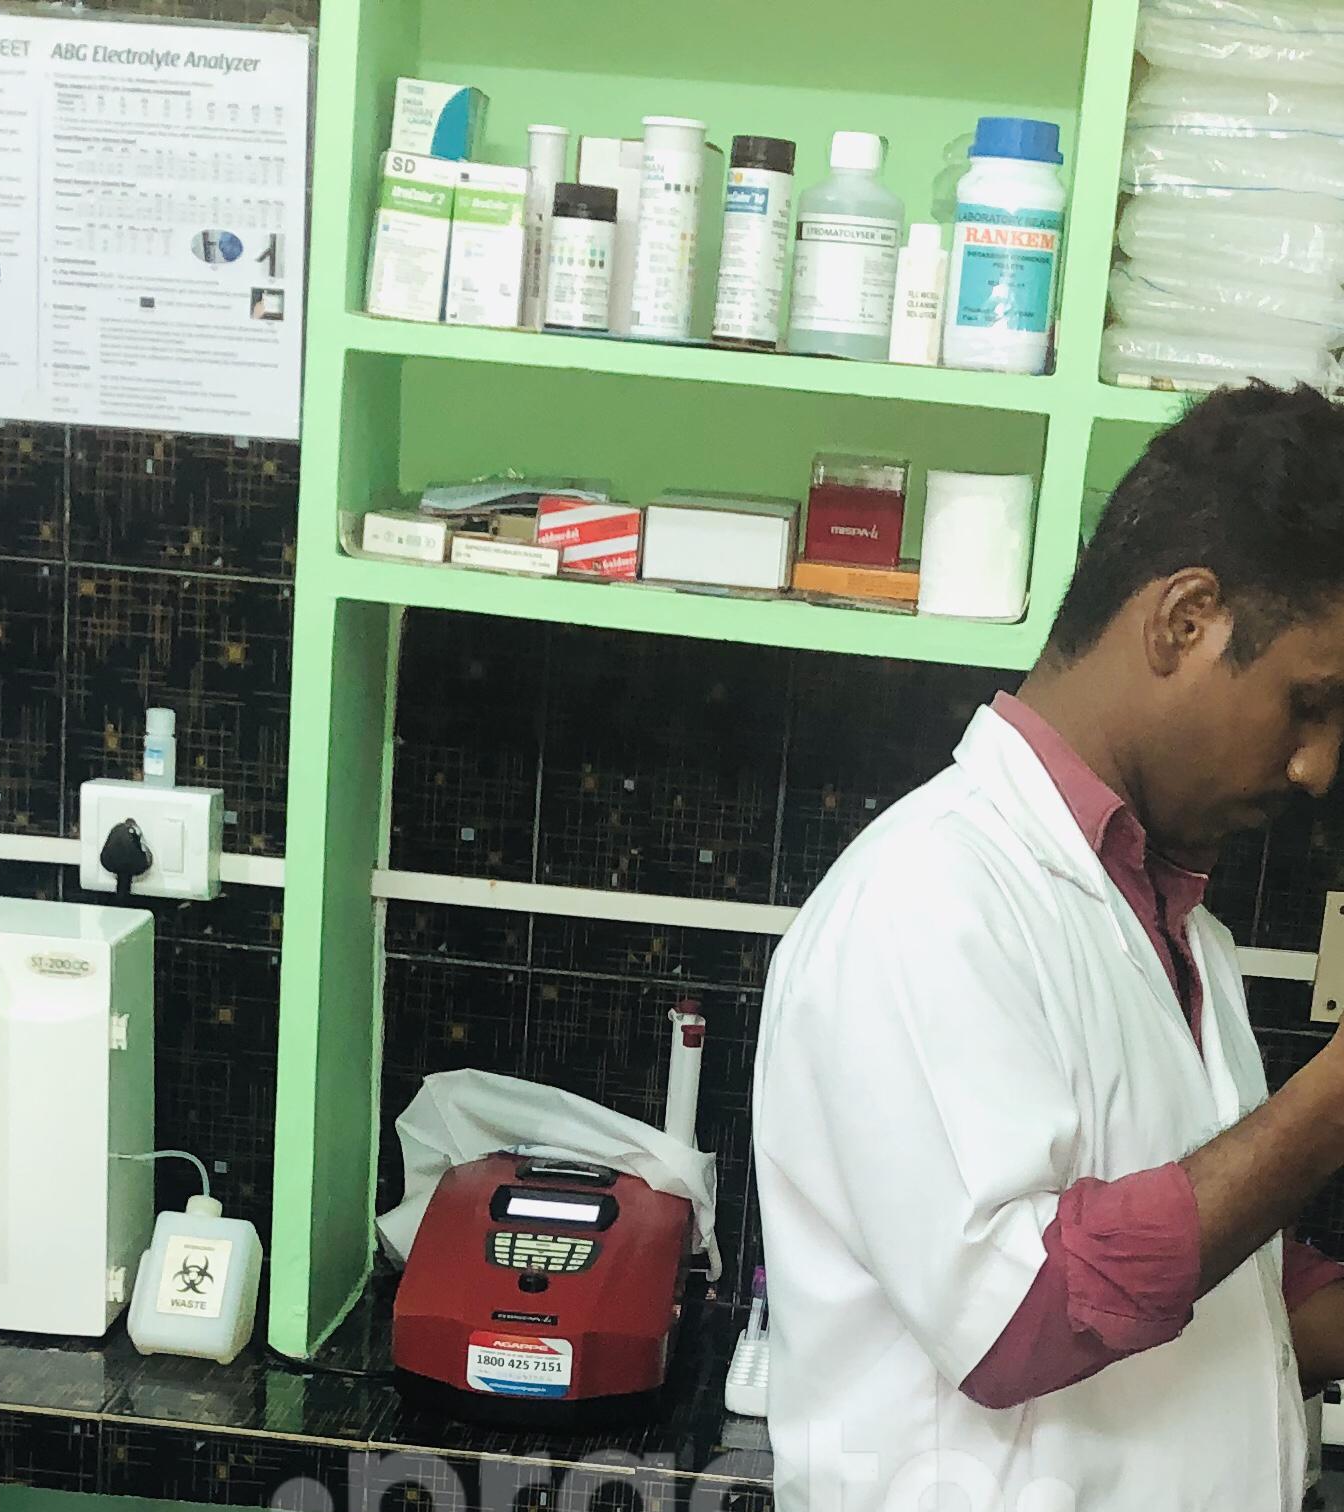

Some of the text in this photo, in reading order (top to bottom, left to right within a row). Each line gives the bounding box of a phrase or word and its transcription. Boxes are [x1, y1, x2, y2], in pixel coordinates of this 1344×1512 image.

[50, 42, 261, 76] ABG Electrolyte Analyzer
[391, 156, 417, 174] SD
[964, 226, 1056, 250] RANKEM
[170, 1298, 208, 1311] WASTE
[476, 1354, 505, 1368] 1800
[507, 1358, 530, 1371] 425
[534, 1361, 563, 1373] 7151
